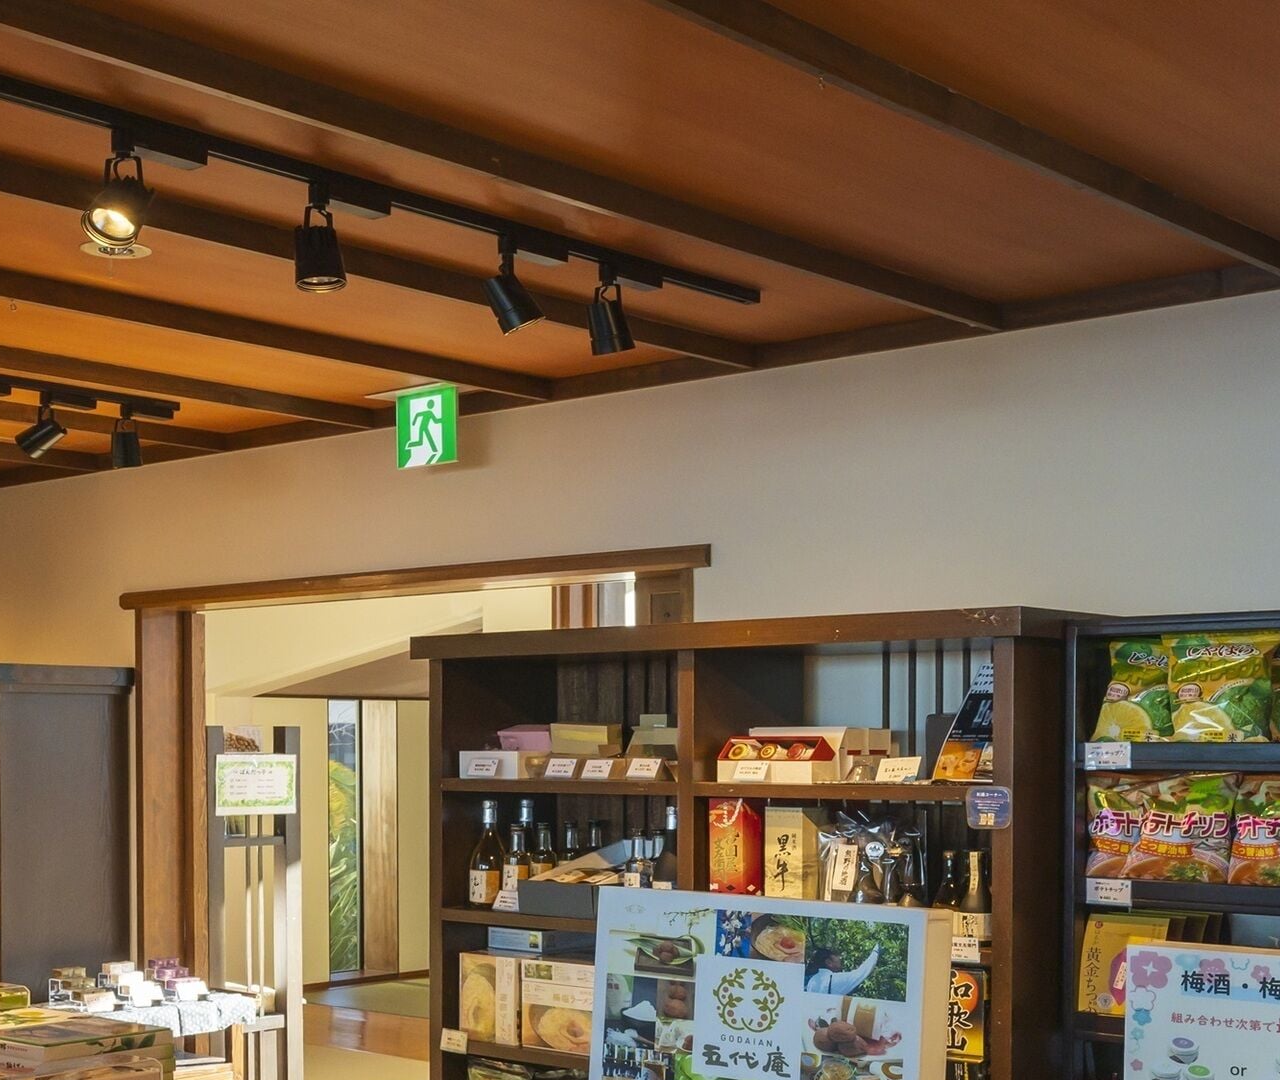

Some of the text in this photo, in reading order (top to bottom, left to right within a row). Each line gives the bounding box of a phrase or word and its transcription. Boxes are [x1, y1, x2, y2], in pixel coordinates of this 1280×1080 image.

[720, 1034, 773, 1048] GODAIAN
[702, 1043, 791, 1078] 五代庵
[1230, 1064, 1247, 1077] or
